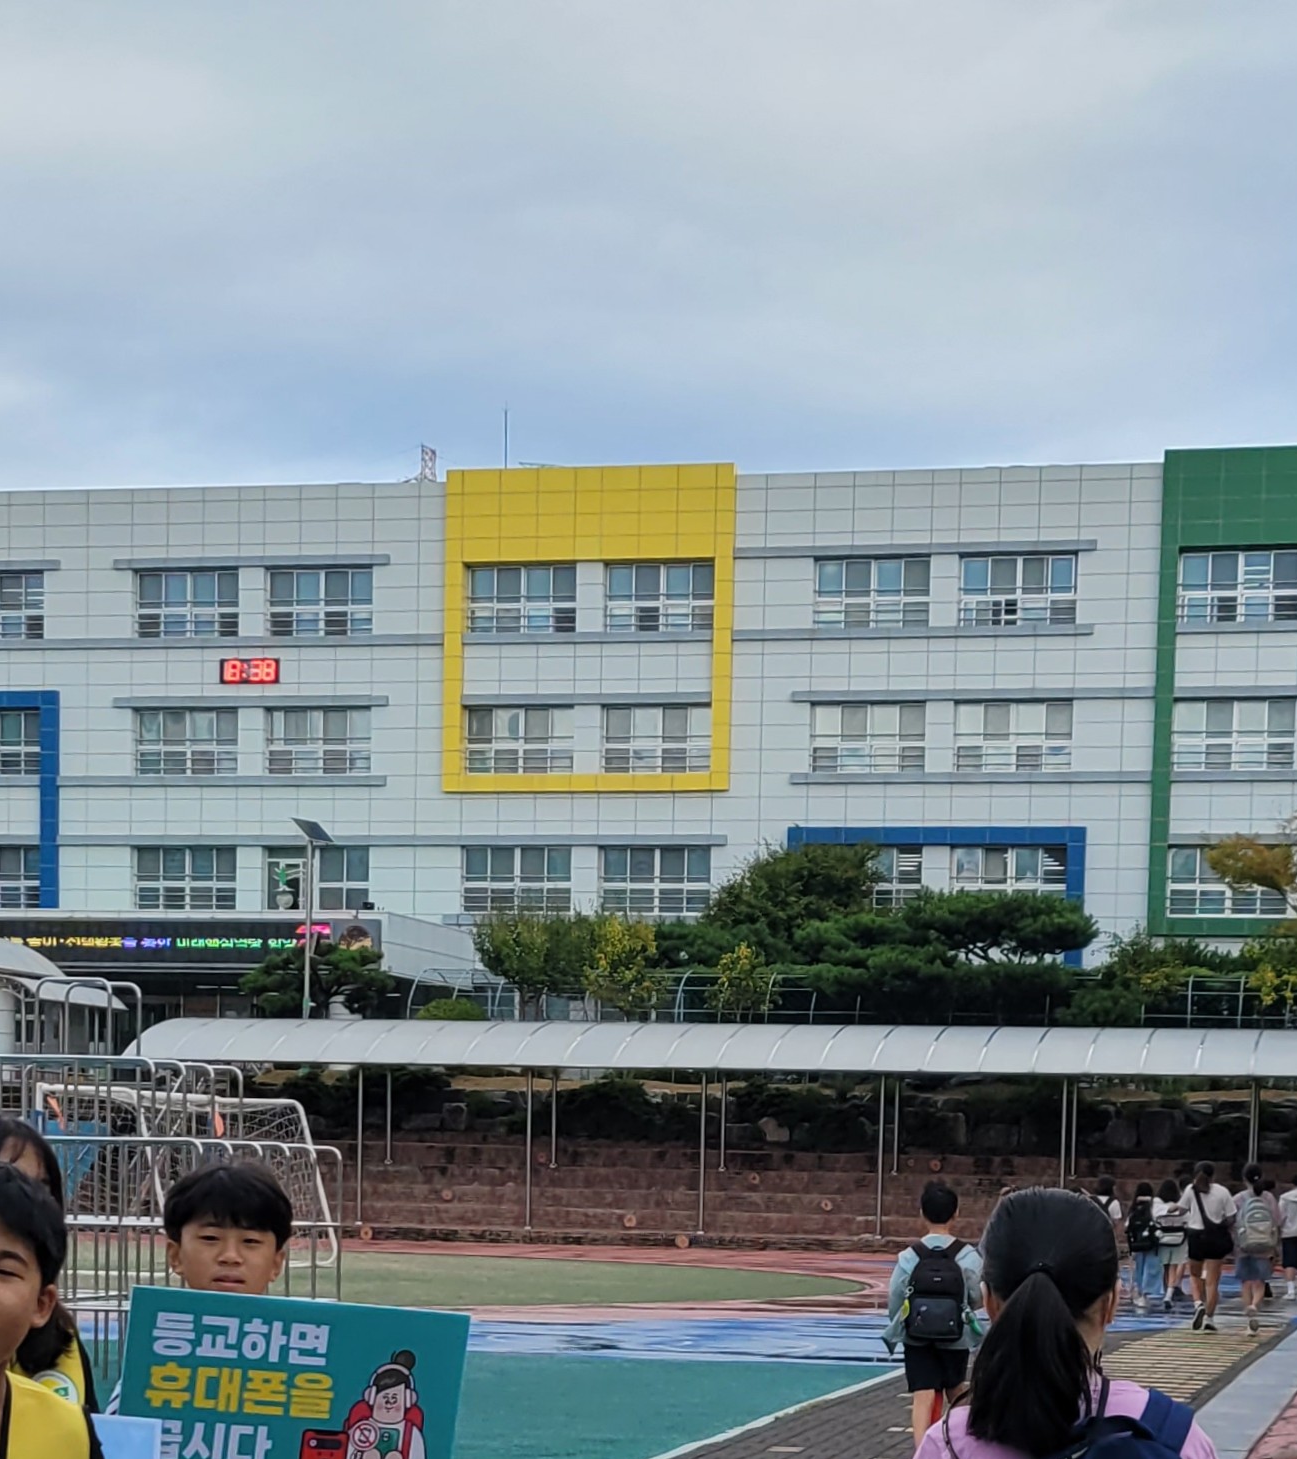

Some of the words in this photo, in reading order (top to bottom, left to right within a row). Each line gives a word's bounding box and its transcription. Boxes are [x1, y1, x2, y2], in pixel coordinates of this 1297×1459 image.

[223, 659, 276, 682] 8:38
[152, 1311, 330, 1366] 등교하면
[145, 1362, 334, 1419] 휴대폰을
